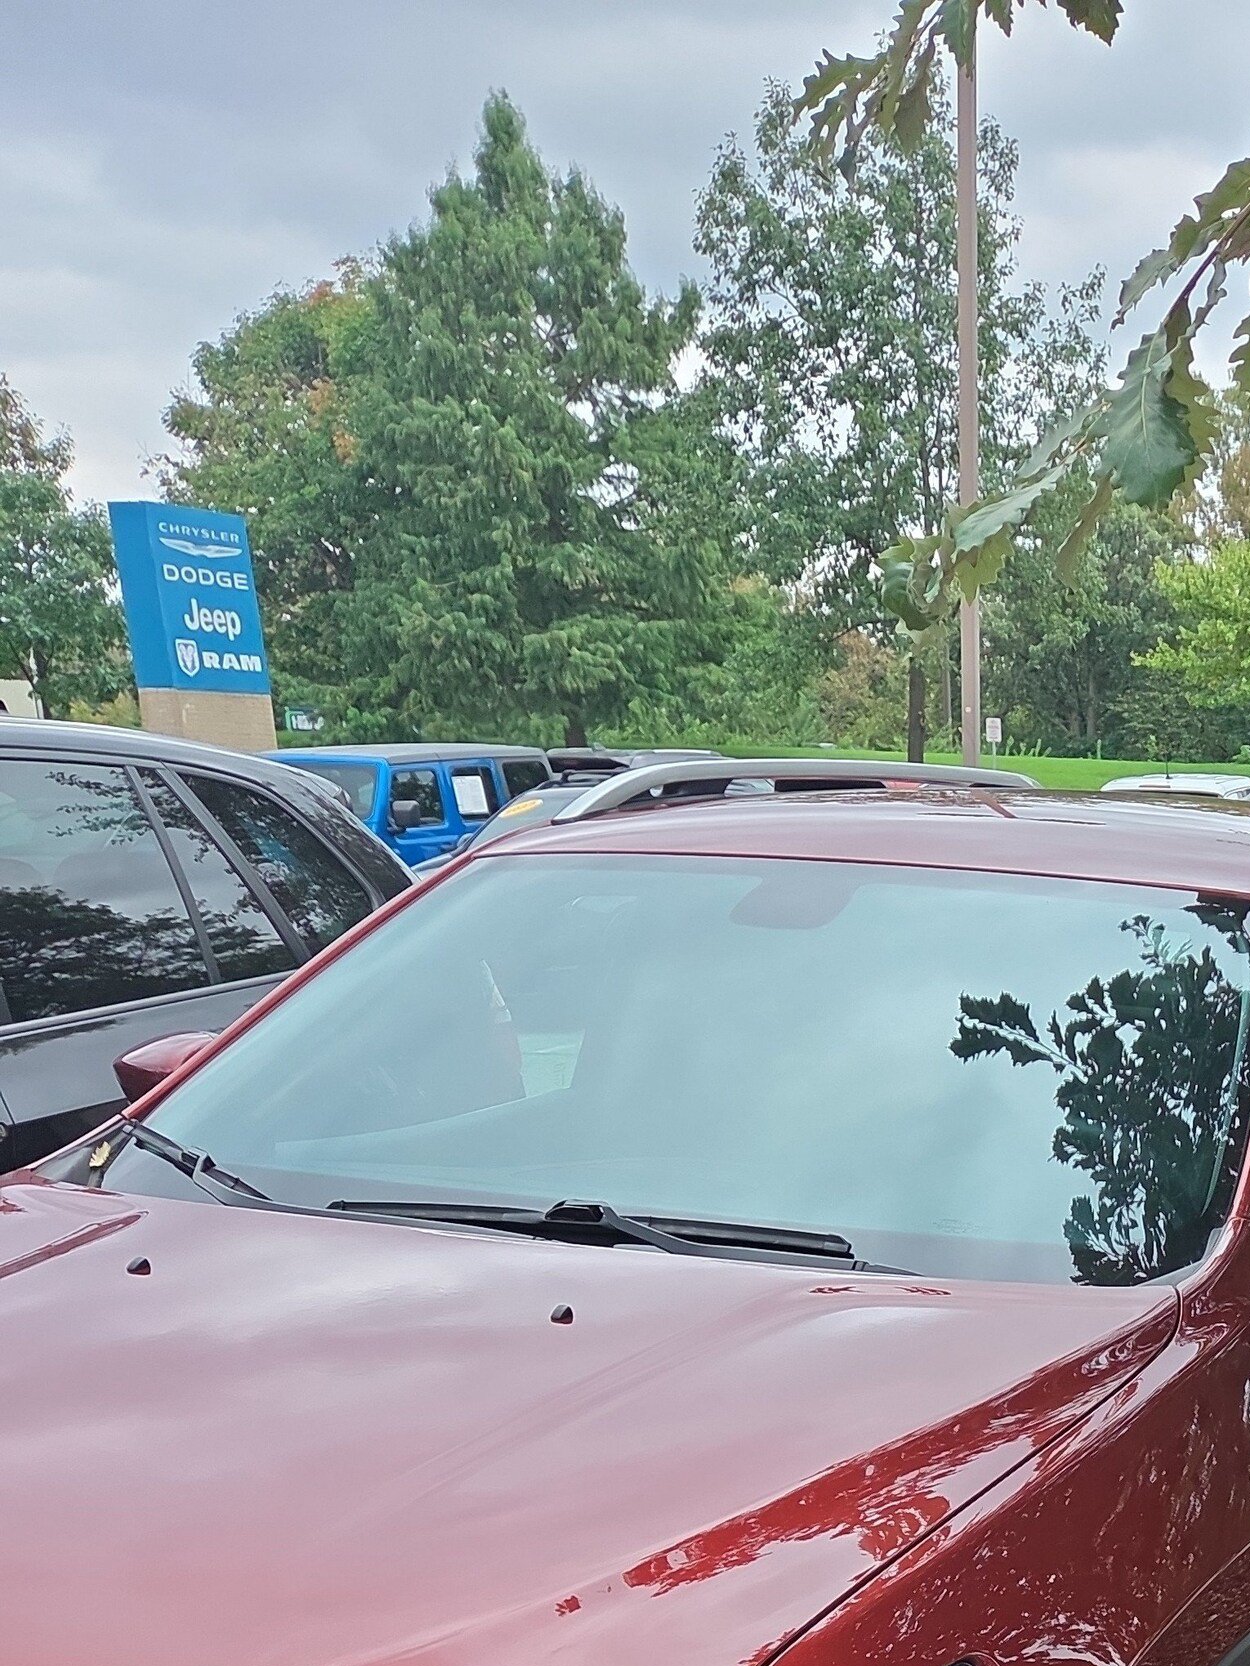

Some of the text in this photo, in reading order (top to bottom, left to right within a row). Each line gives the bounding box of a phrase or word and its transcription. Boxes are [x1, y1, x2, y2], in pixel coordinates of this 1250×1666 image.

[158, 522, 239, 543] CHRYSLER
[162, 564, 249, 590] DODGE
[183, 598, 241, 641] Jeep
[202, 651, 262, 672] RAM
